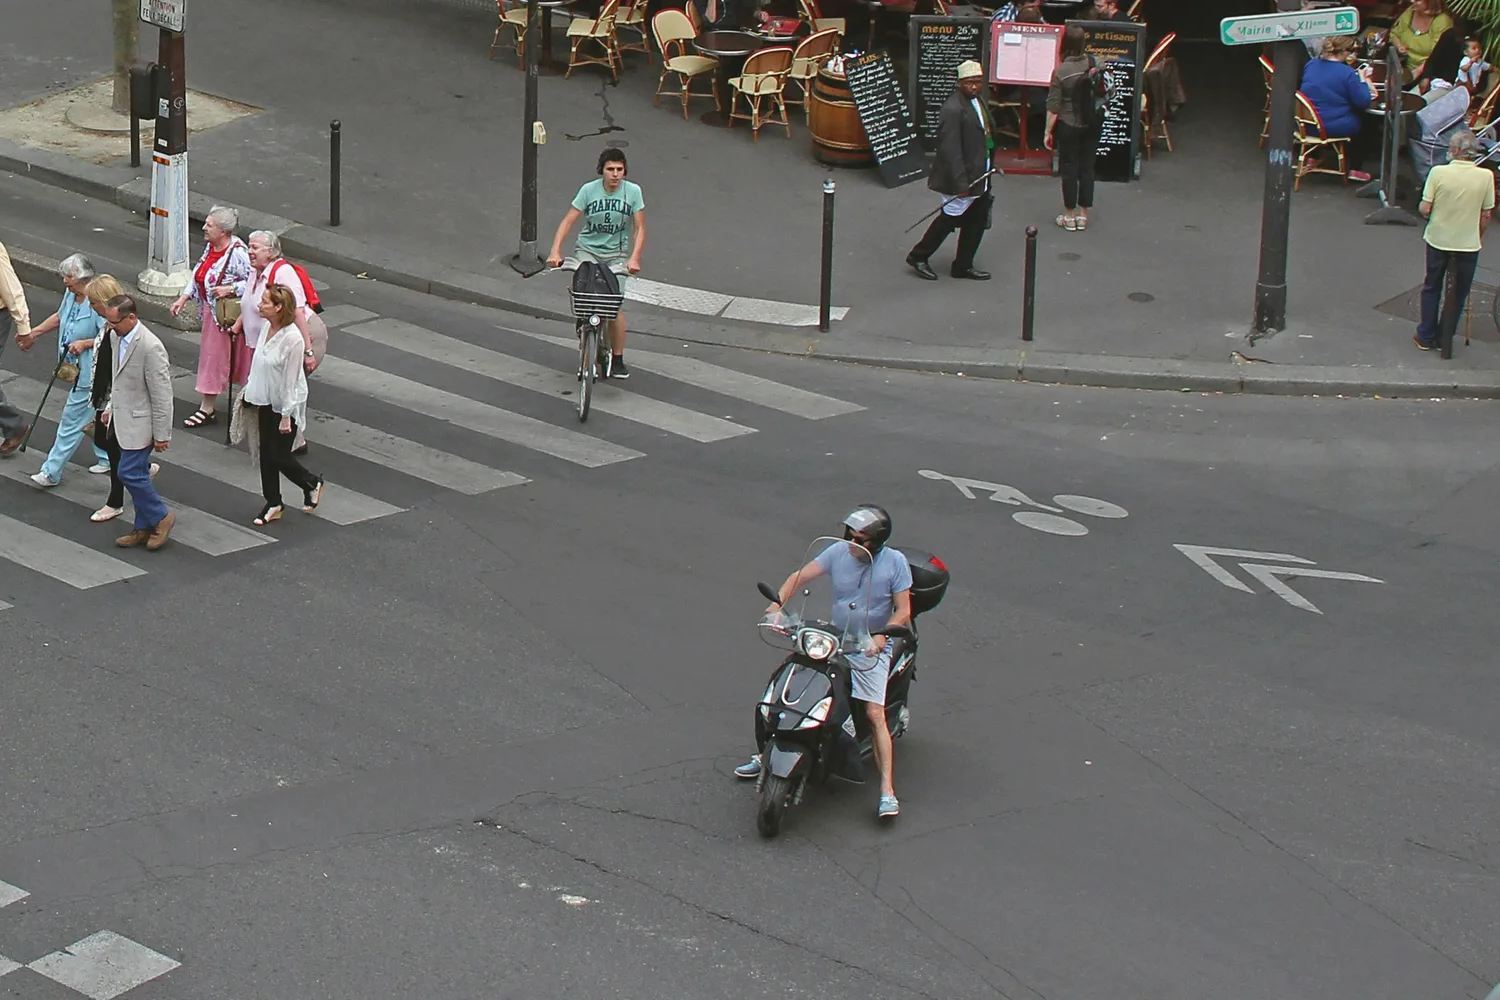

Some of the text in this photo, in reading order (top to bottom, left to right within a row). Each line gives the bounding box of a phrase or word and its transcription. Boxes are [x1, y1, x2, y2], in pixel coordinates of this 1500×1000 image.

[922, 25, 953, 34] menu
[1011, 25, 1046, 33] MENU
[1238, 25, 1271, 37] Mairie
[1095, 32, 1136, 42] artisans
[585, 199, 633, 216] FRANKLIN
[604, 211, 611, 223] &
